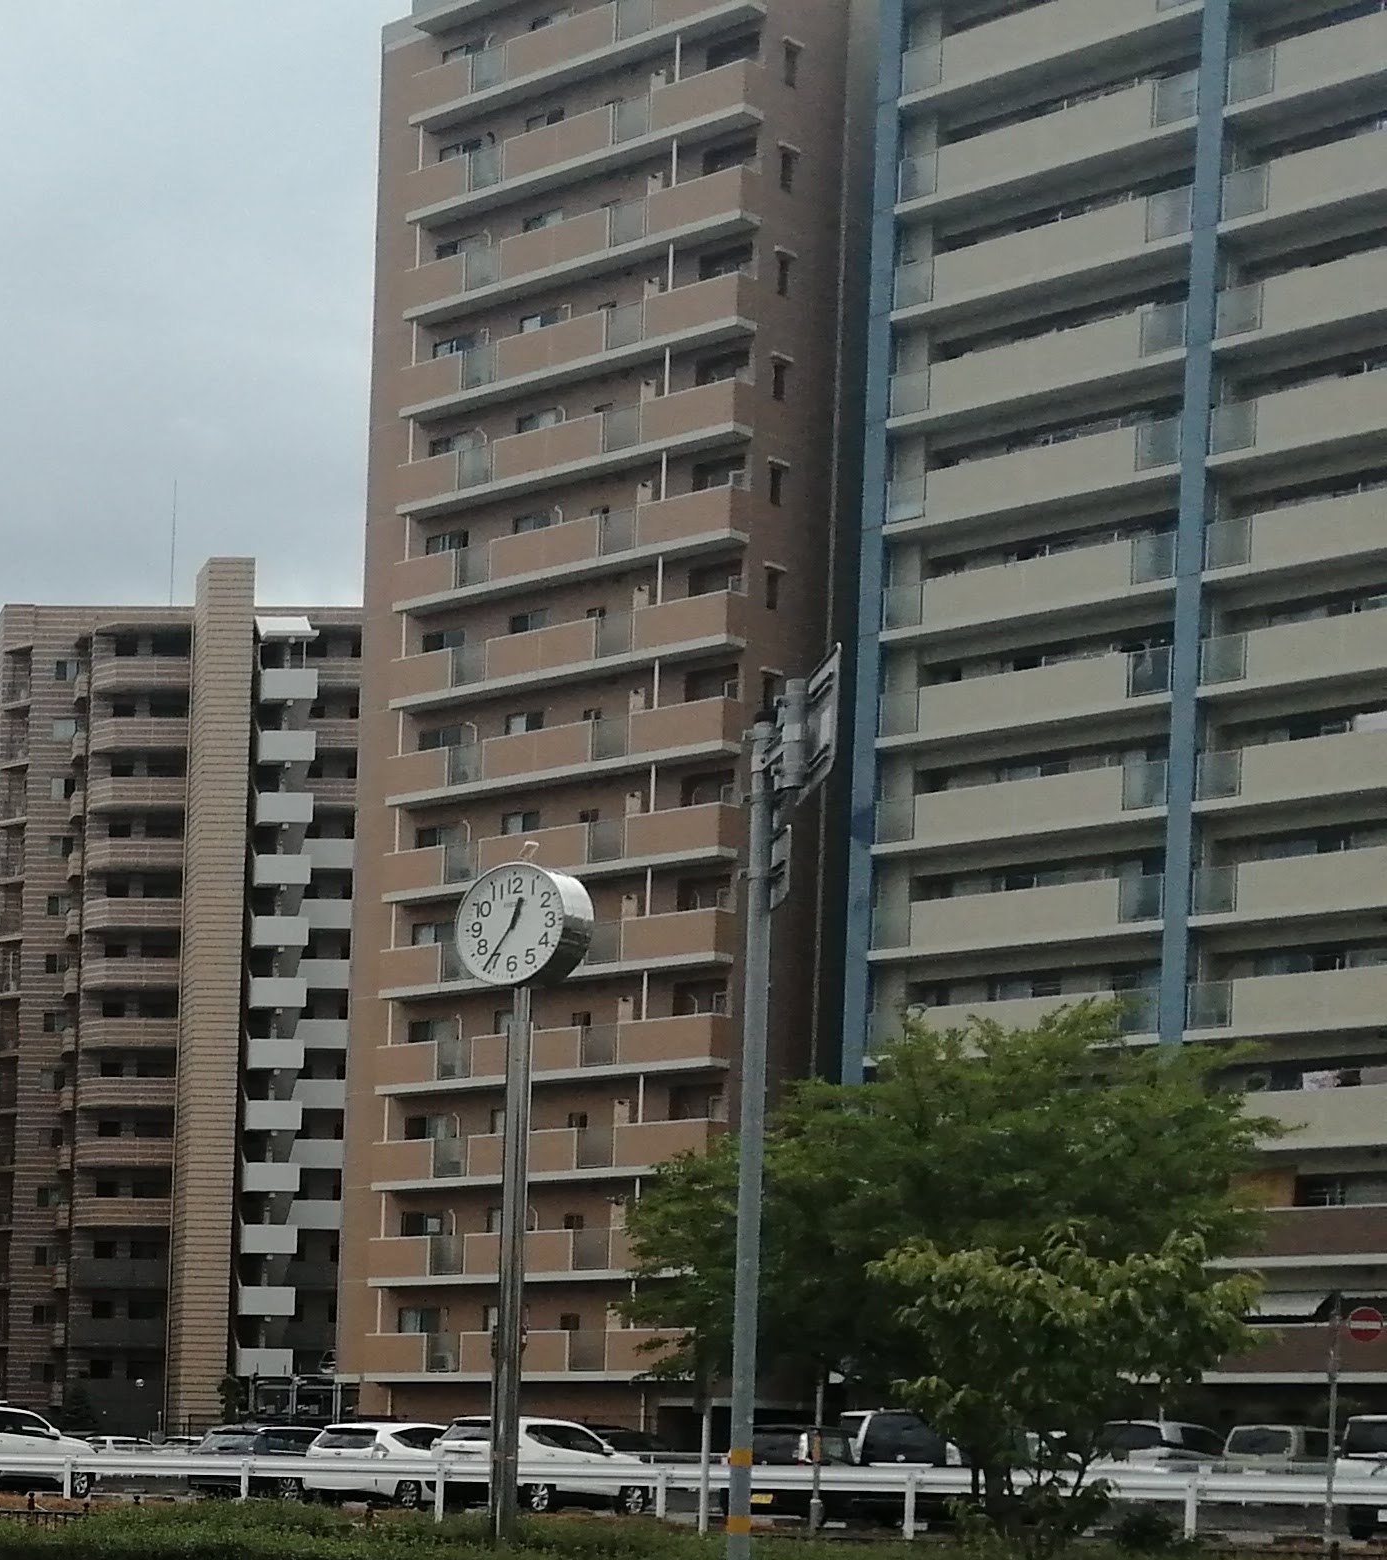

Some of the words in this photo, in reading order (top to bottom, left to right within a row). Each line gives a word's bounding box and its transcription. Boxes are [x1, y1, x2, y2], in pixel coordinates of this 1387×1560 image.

[492, 883, 504, 901] 11
[508, 877, 523, 894] 12
[540, 891, 552, 909] 2
[472, 900, 492, 918] 10
[544, 911, 556, 928] 3
[471, 921, 483, 939] 9
[476, 938, 488, 956] 8
[538, 932, 549, 948] 4
[506, 955, 518, 972] 6
[524, 948, 536, 965] 5
